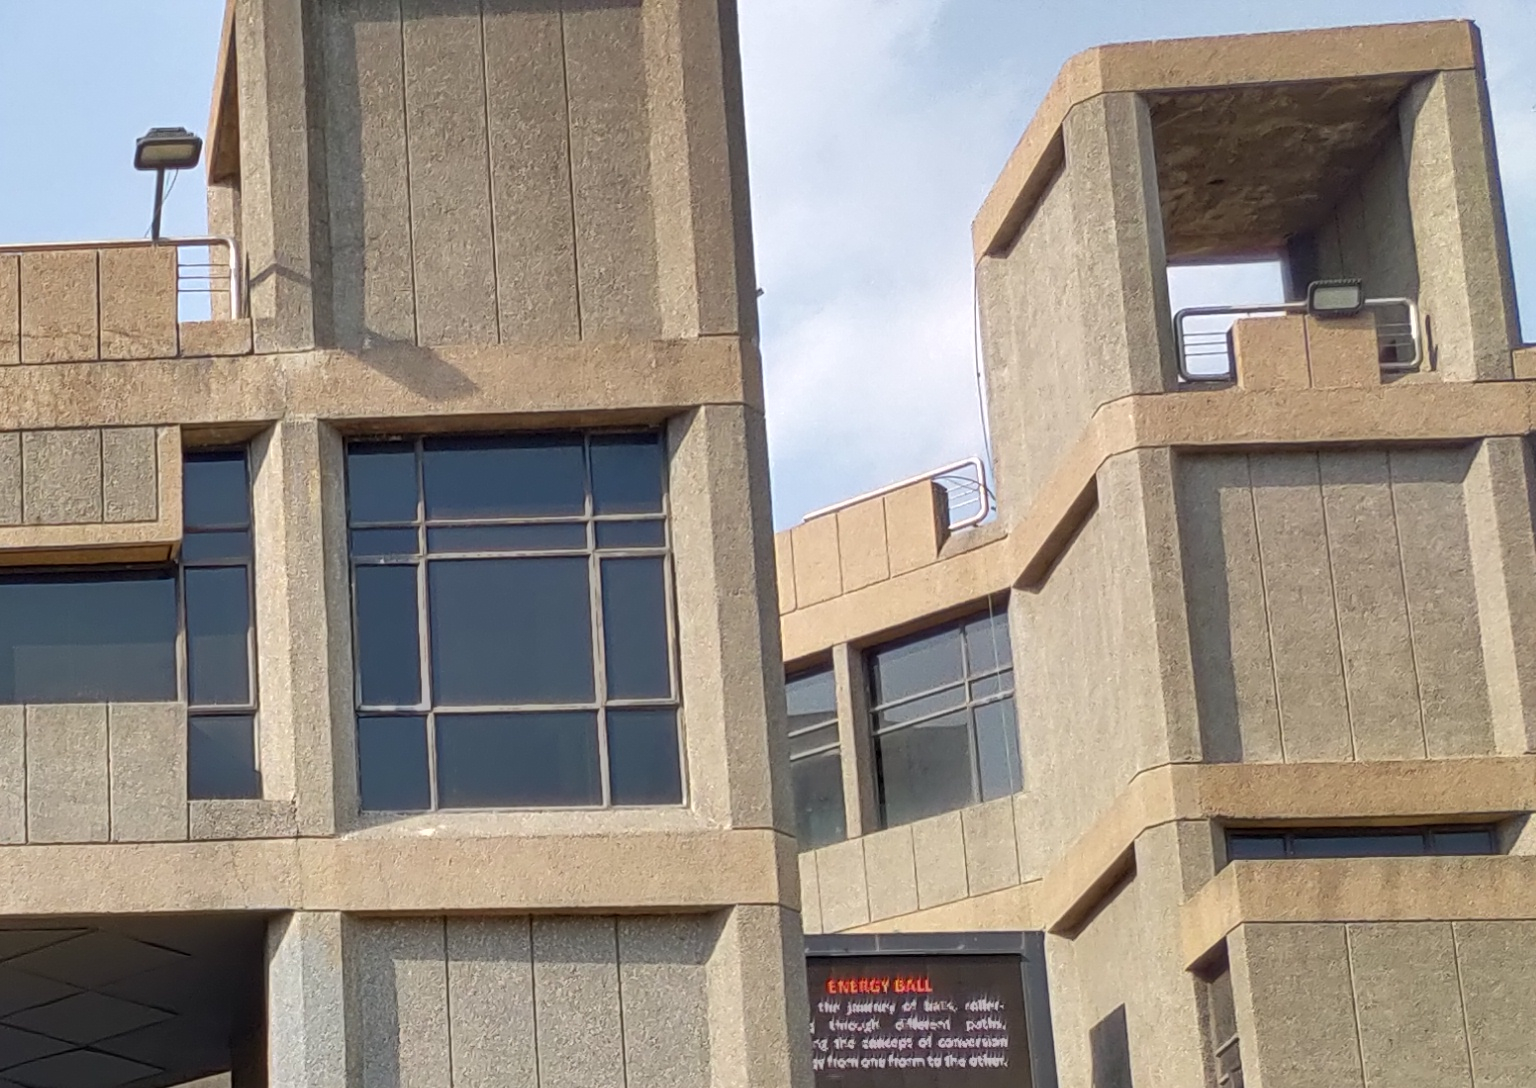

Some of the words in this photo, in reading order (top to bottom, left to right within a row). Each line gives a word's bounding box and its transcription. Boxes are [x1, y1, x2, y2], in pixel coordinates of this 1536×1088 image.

[826, 977, 890, 994] ENERGY
[893, 977, 933, 993] BALL
[818, 999, 840, 1013] the
[847, 999, 896, 1015] journey
[829, 1018, 880, 1034] through
[833, 1036, 855, 1050] the
[918, 1034, 932, 1048] of
